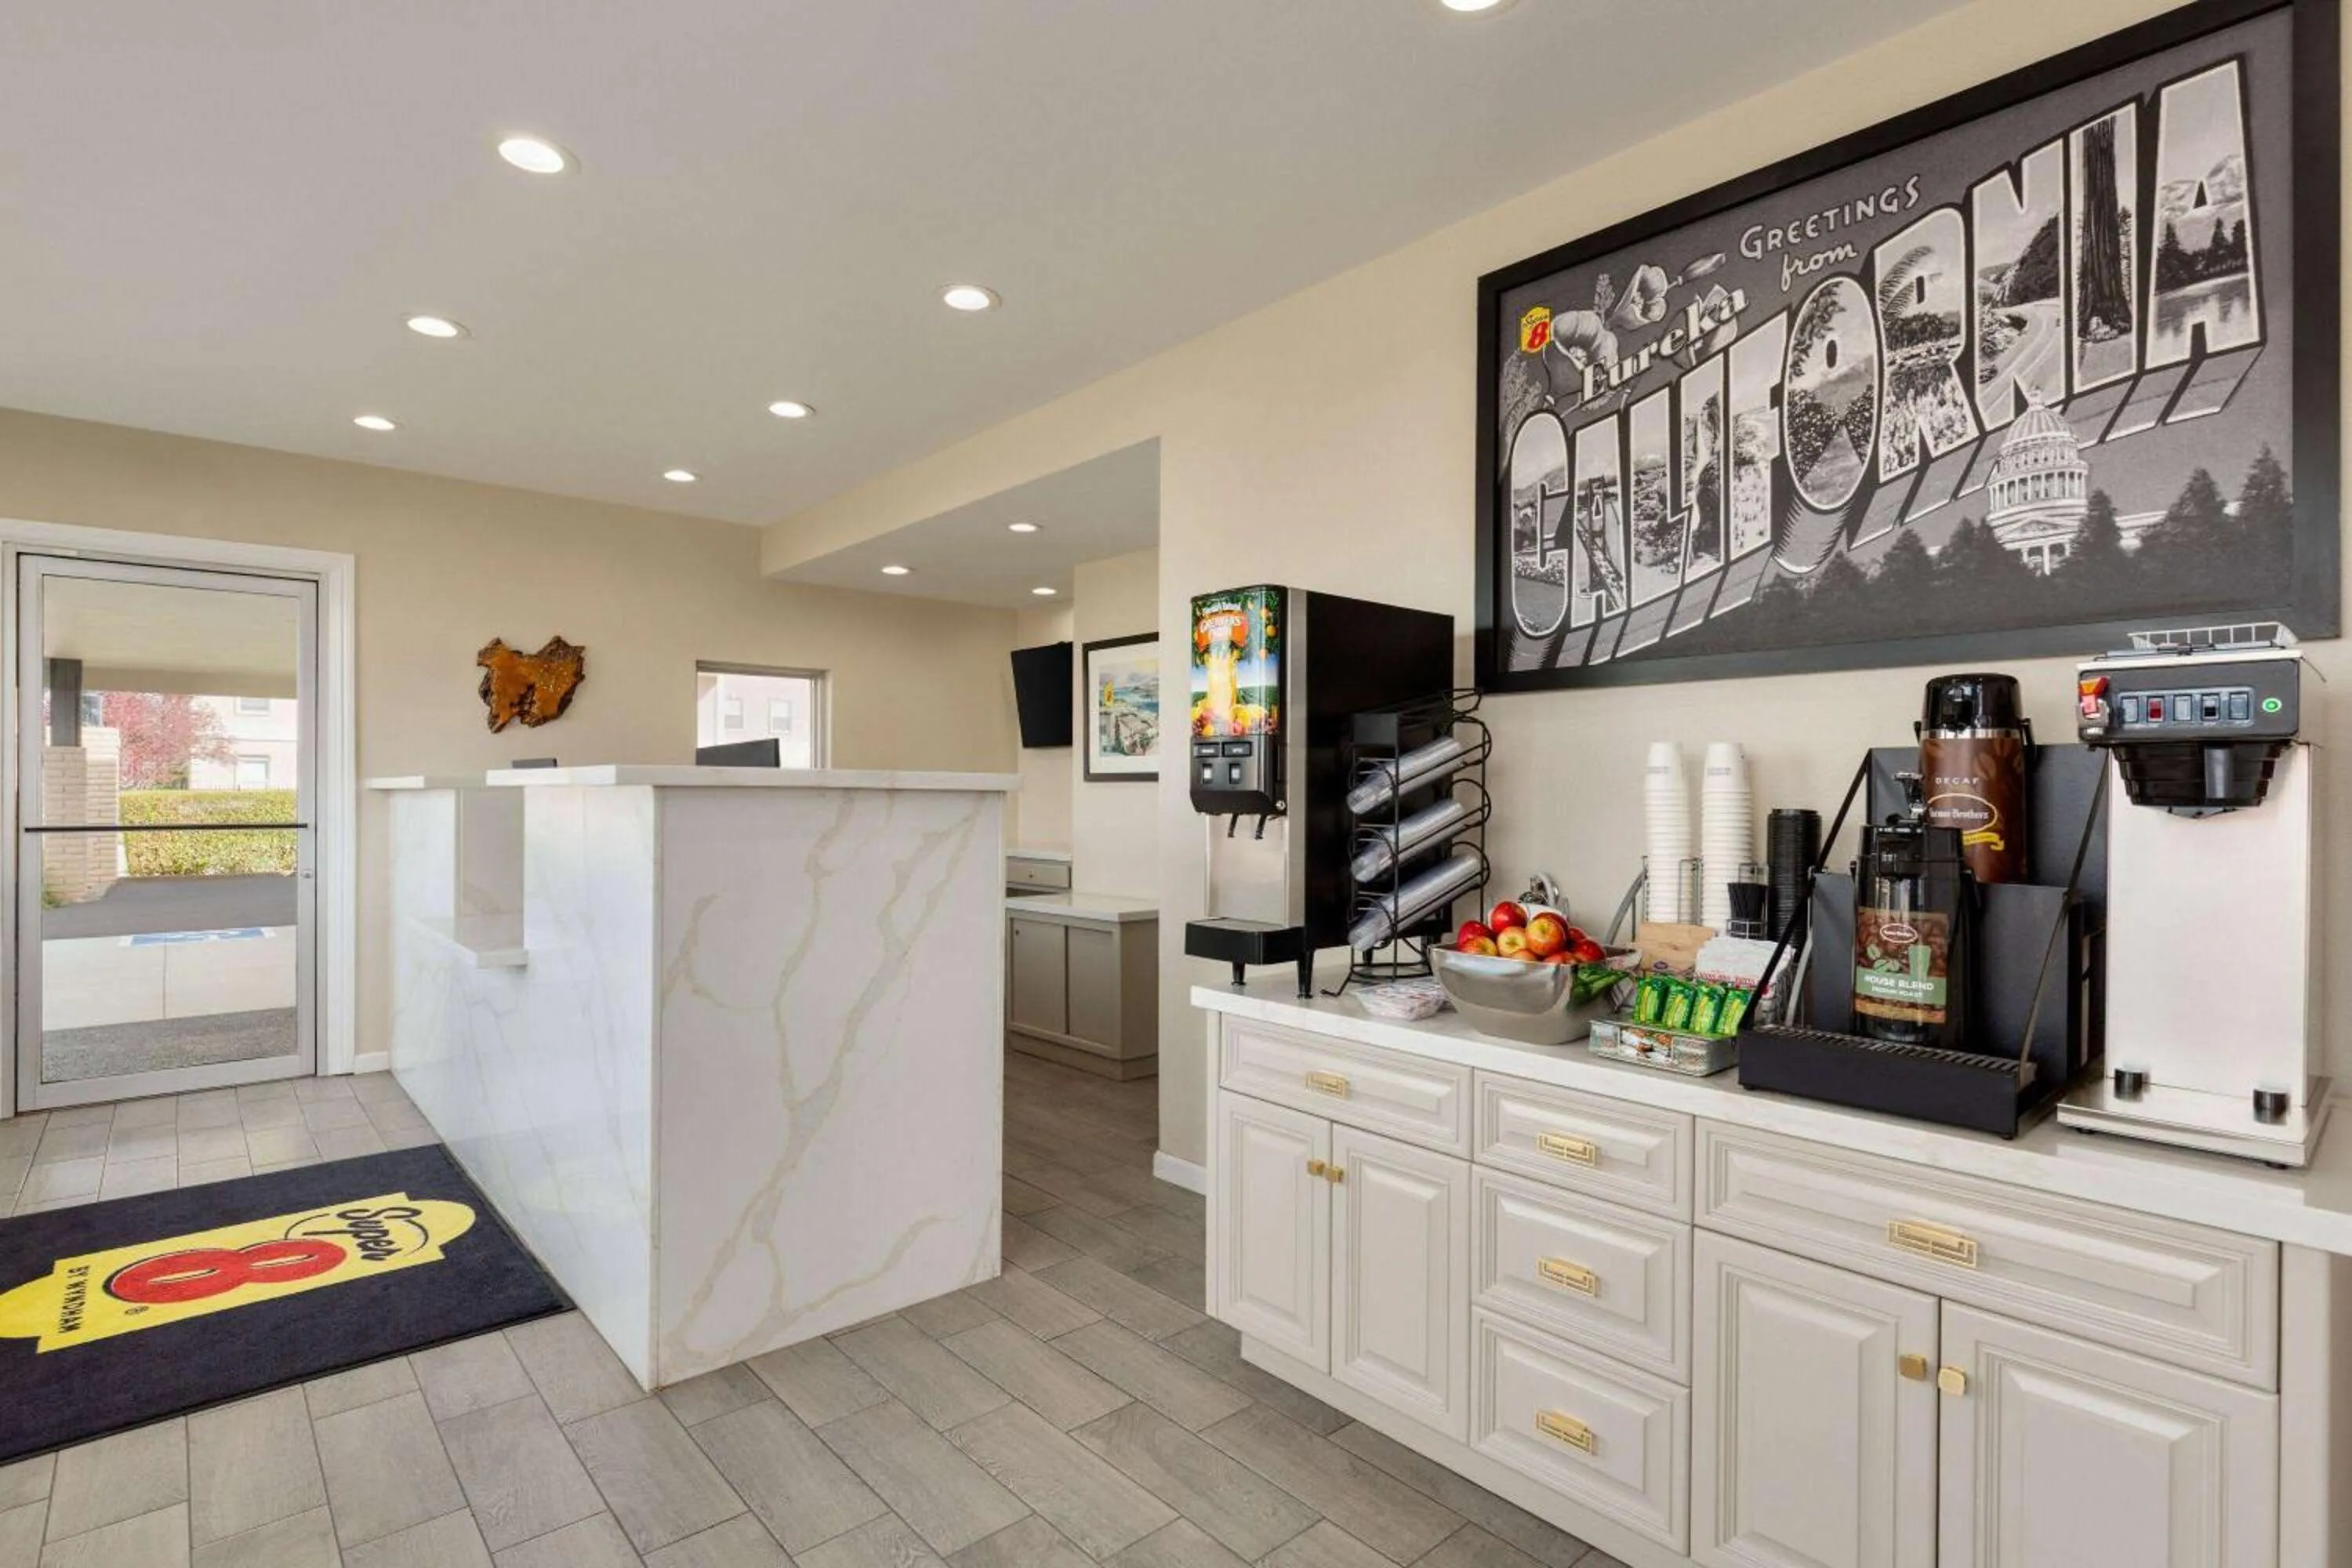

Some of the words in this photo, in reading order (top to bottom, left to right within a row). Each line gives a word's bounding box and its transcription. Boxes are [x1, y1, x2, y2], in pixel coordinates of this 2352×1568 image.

[1739, 174, 1920, 260] GREETINGS
[1780, 243, 1857, 292] from
[1511, 59, 2260, 637] CALIFORNIA
[1528, 321, 1548, 350] 8
[1582, 289, 1749, 401] Eureka
[1898, 979, 1935, 991] BLEND
[303, 1206, 423, 1261] Super
[67, 1265, 90, 1279] BY
[103, 1239, 347, 1305] 8
[58, 1279, 88, 1334] WYNDHAM
